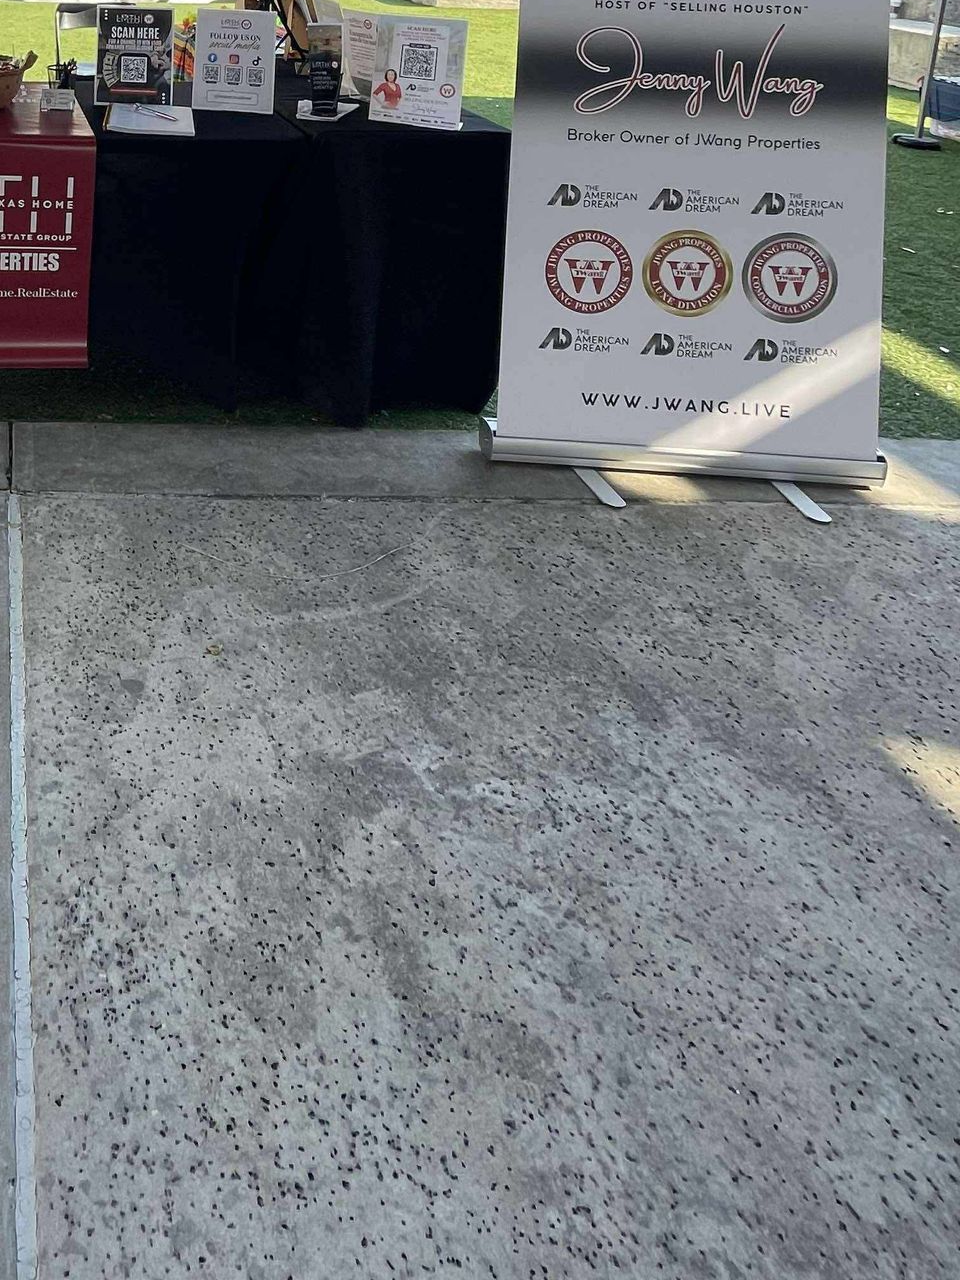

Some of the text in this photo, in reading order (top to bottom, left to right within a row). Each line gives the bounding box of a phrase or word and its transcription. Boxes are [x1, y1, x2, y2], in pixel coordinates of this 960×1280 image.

[595, 0, 630, 9] HOST
[637, 0, 656, 10] OF
[111, 26, 160, 39] SCAN HERE
[573, 23, 824, 119] Jenny Wang
[567, 128, 821, 151] Broker Owner of JWang Properties
[32, 200, 74, 209] HOME
[37, 234, 72, 242] GROUP
[581, 392, 790, 418] WWW.JWANG.LIVE
